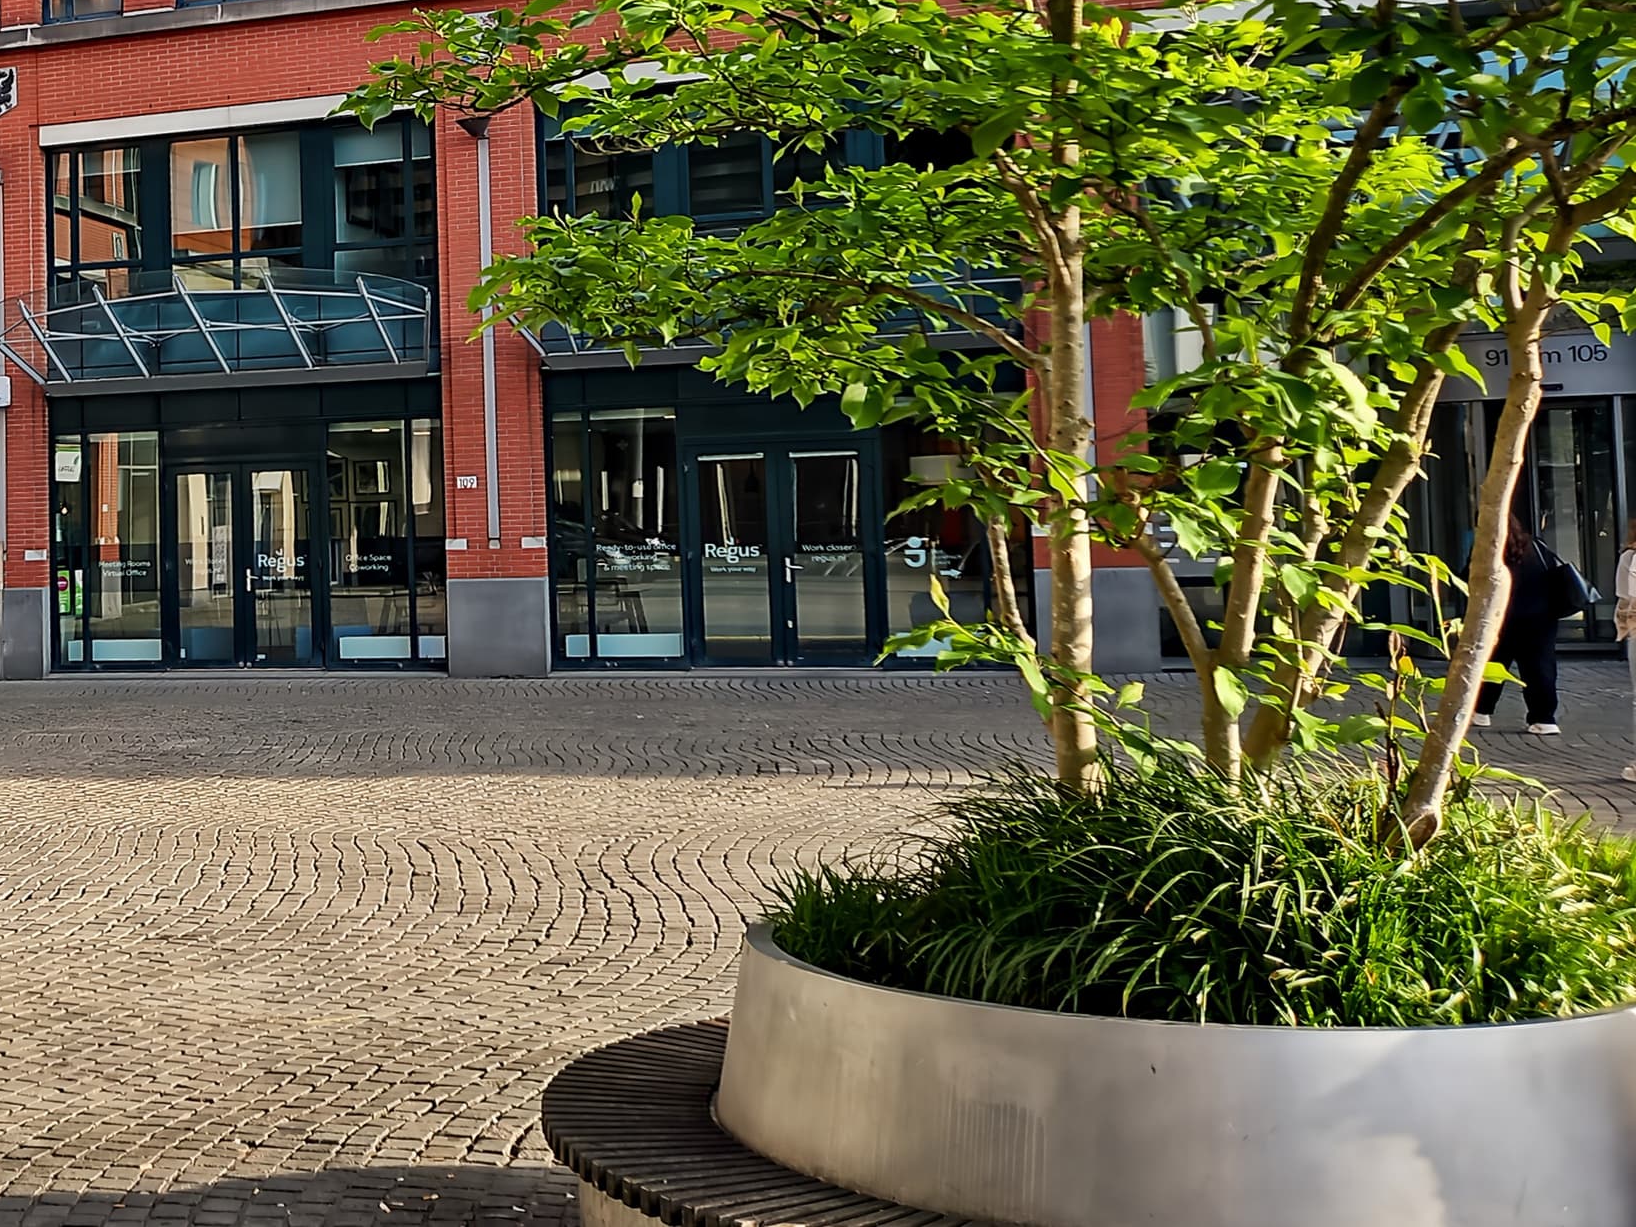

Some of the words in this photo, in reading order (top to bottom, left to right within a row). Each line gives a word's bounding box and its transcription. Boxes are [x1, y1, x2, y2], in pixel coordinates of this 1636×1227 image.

[1485, 349, 1508, 366] 91
[1567, 344, 1608, 363] 105
[459, 477, 475, 488] 109
[257, 553, 305, 573] Regus
[369, 554, 392, 562] Space
[704, 543, 760, 563] Regus
